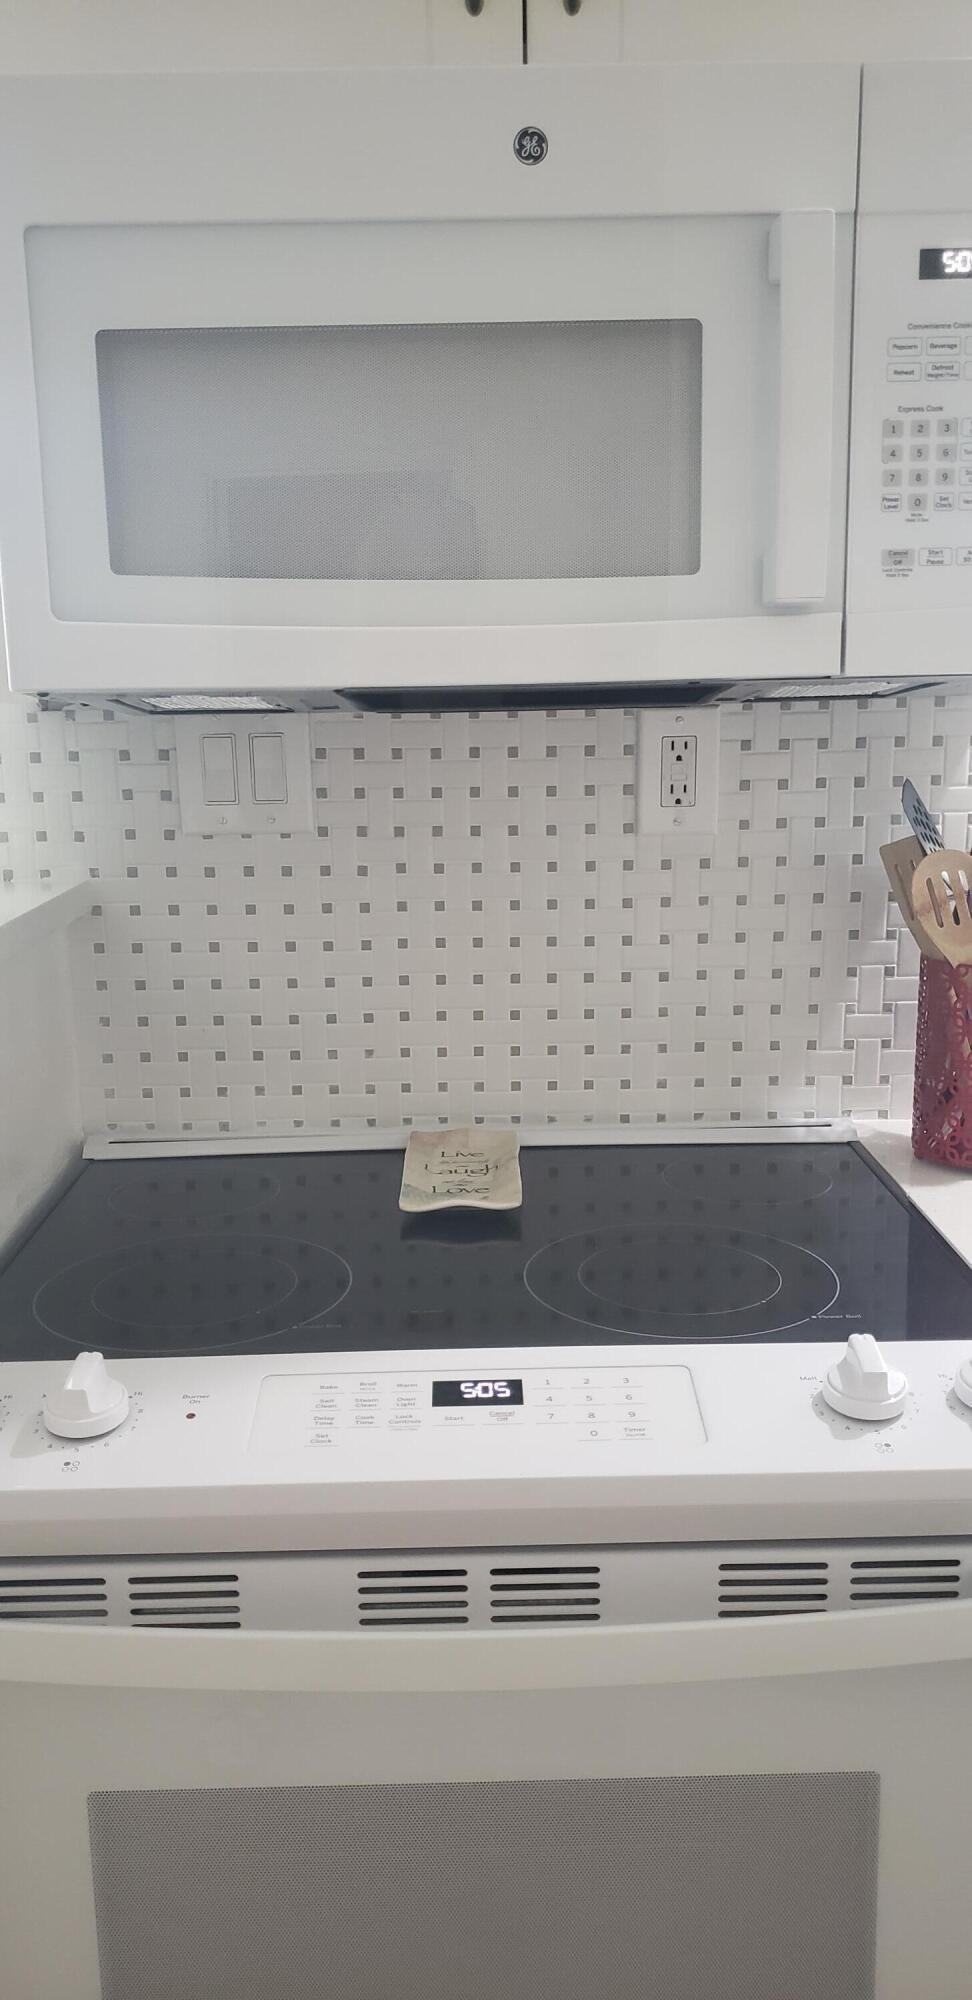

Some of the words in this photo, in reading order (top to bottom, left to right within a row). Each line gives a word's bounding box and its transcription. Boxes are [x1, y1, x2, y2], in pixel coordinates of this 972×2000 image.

[890, 424, 897, 434] 1
[917, 424, 924, 434] 2
[943, 423, 950, 433] 3
[889, 449, 896, 457] 4
[916, 448, 923, 458] 5
[942, 448, 949, 457] 6
[889, 473, 896, 482] 7
[915, 472, 922, 482] 8
[941, 472, 949, 481] 9
[914, 498, 922, 507] 0
[424, 1163, 499, 1177] Laugh
[432, 1186, 491, 1194] Love
